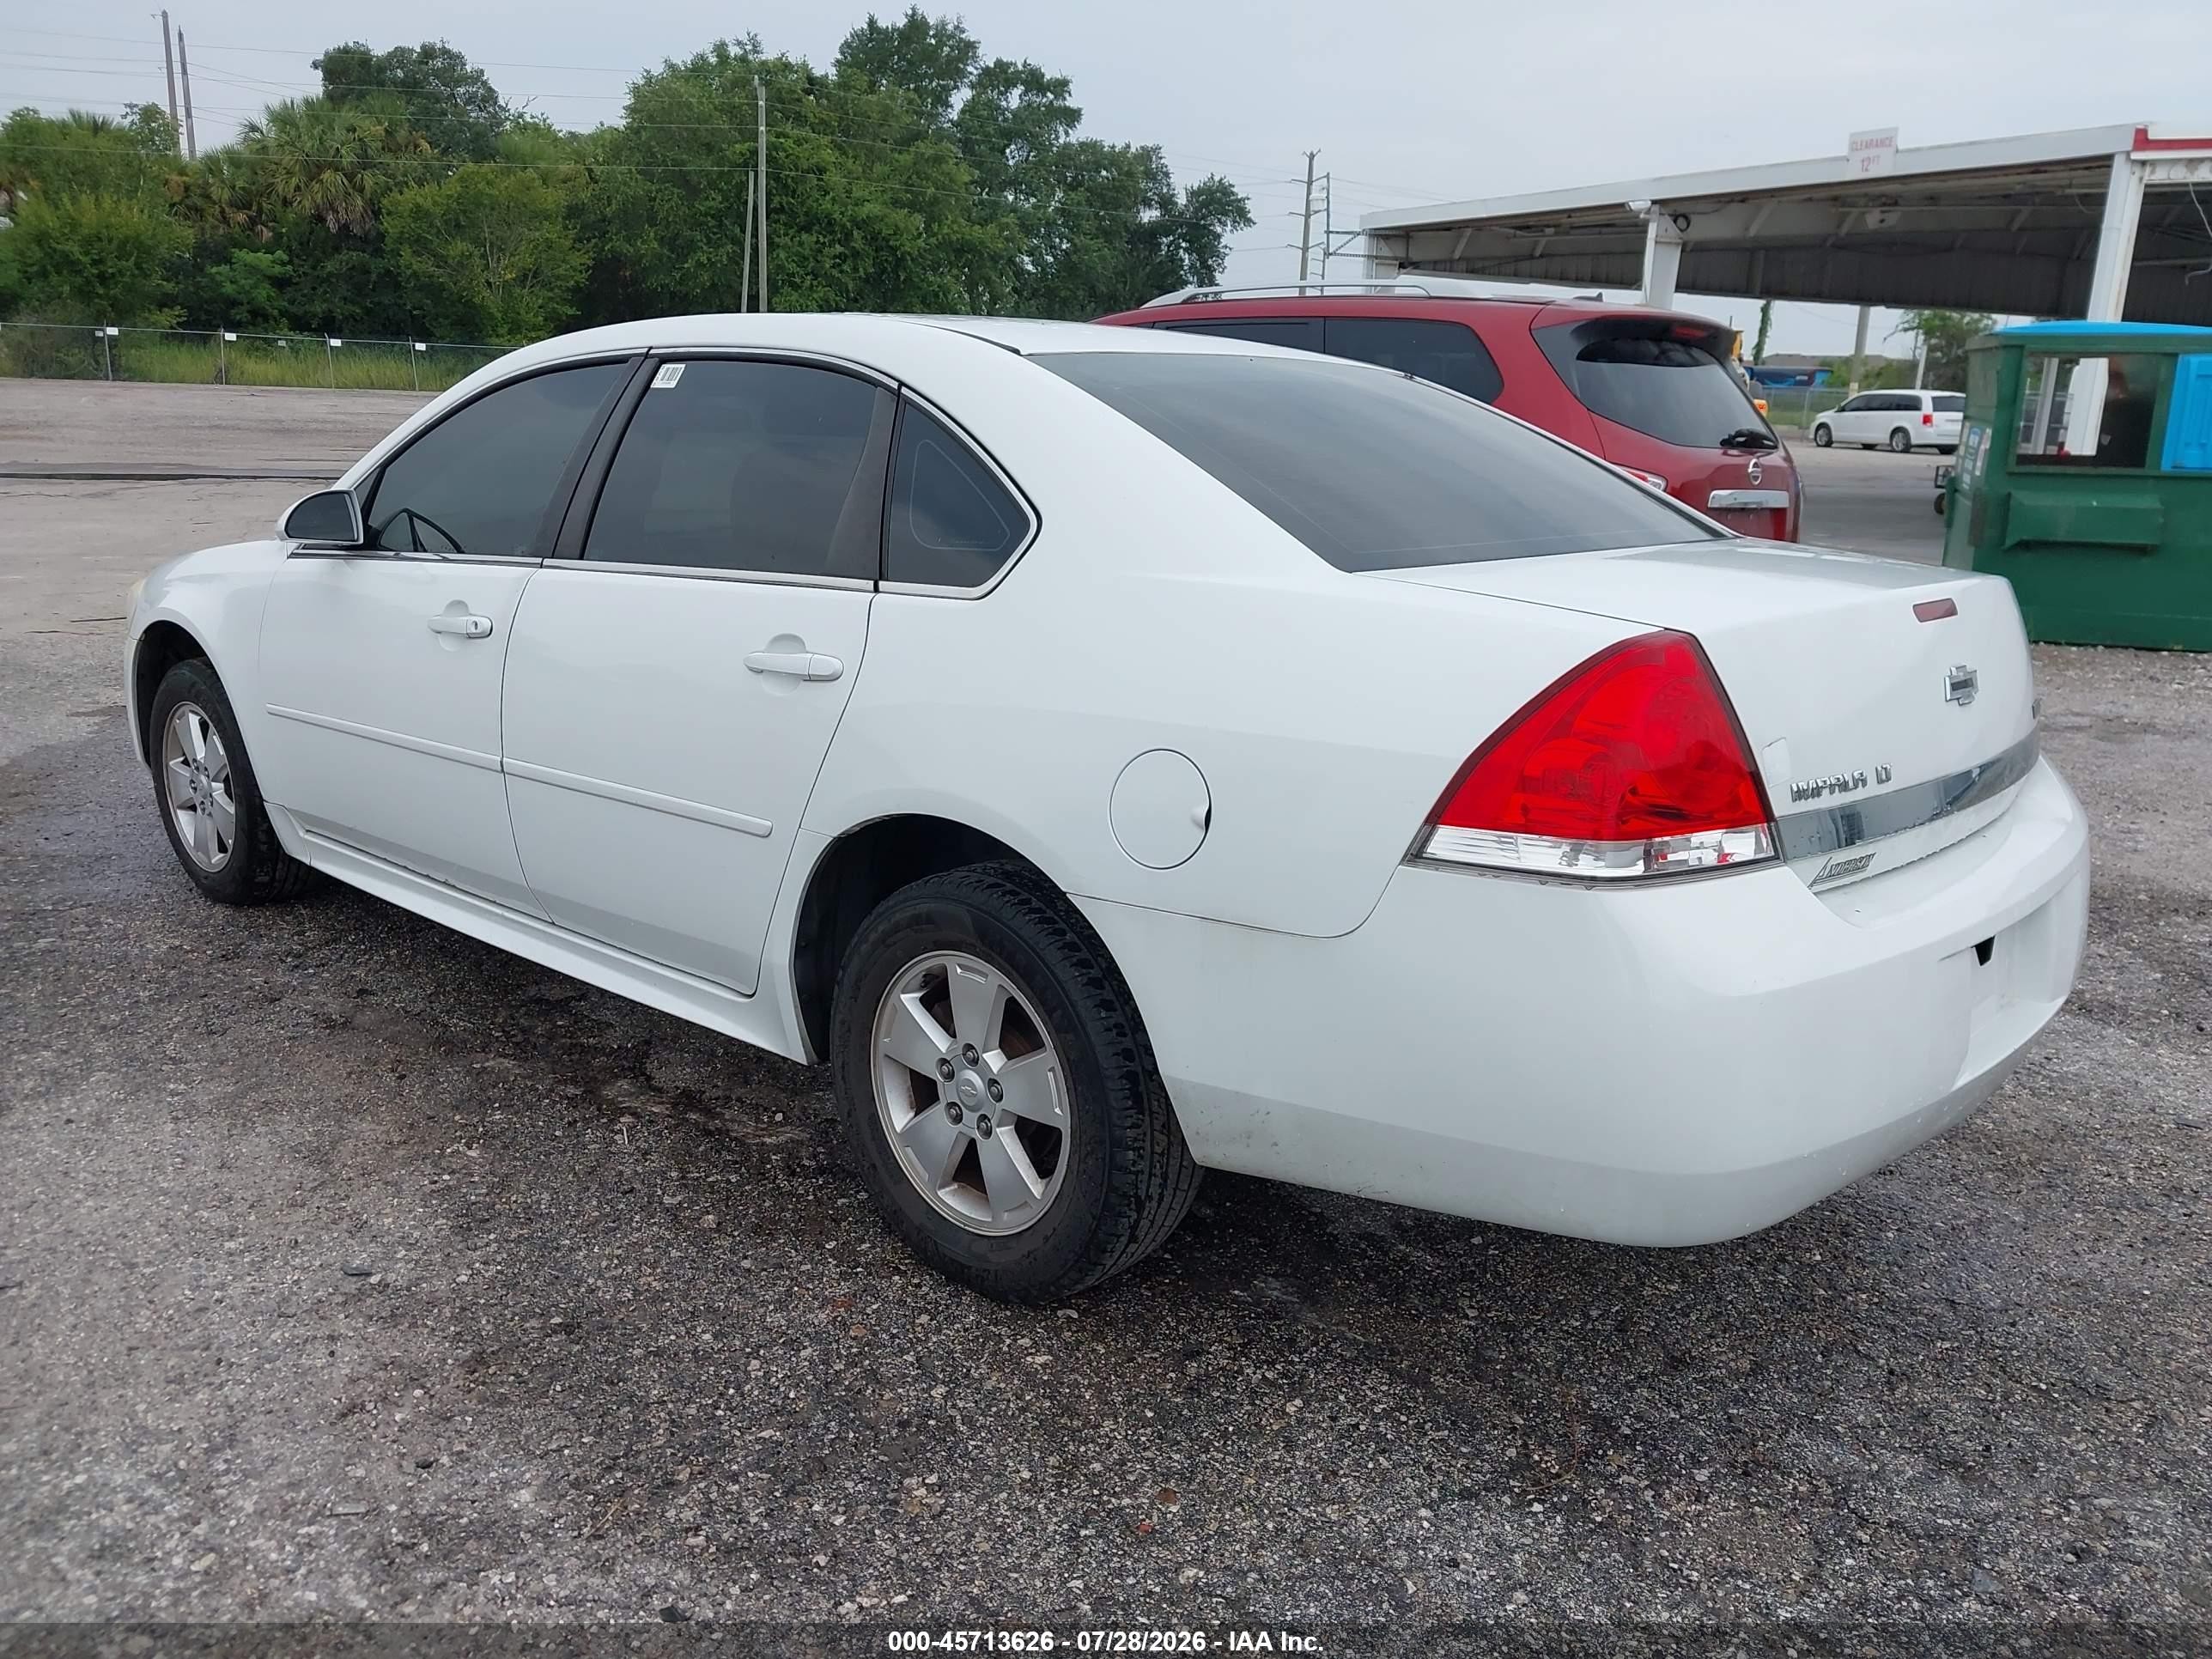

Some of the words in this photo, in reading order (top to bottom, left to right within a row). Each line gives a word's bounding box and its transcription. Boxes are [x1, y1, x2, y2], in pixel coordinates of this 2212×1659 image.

[1850, 137, 1894, 152] CLEARANCE
[1790, 769, 1868, 802] IMPALA
[1875, 763, 1893, 784] LT
